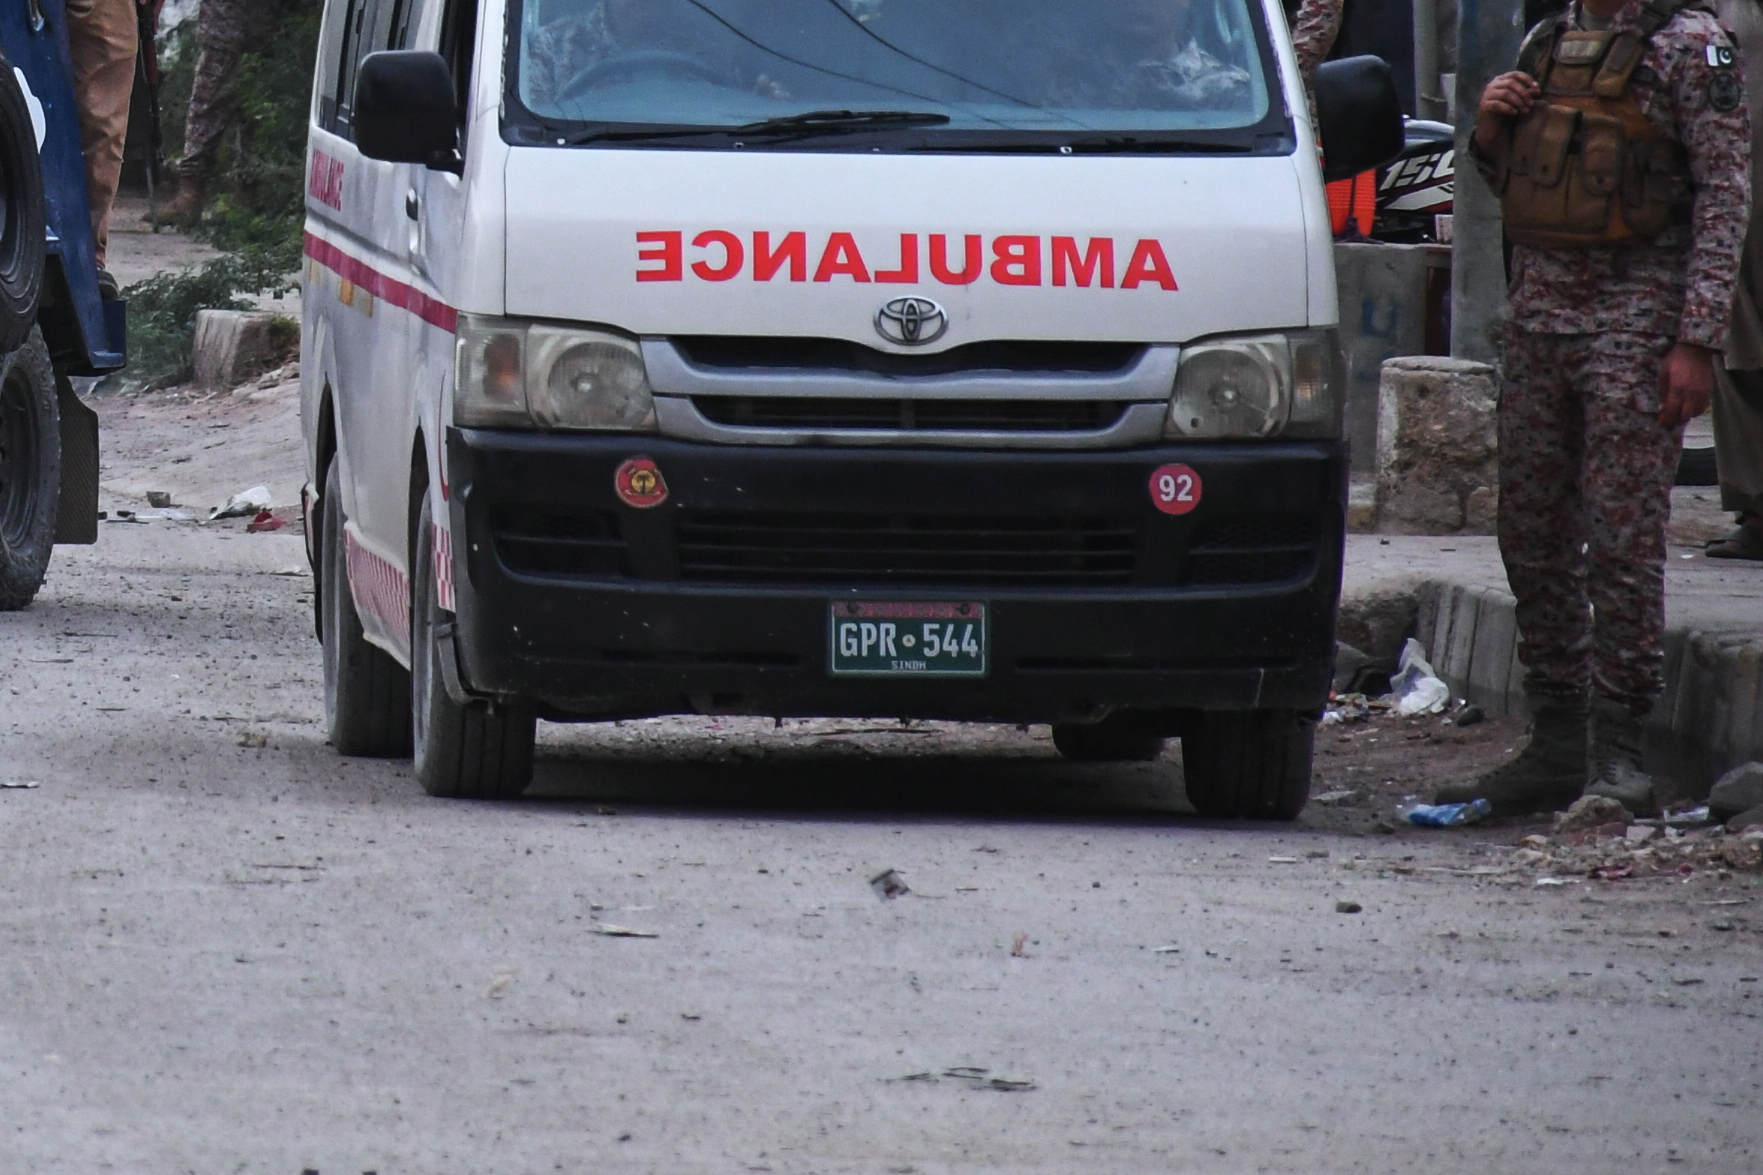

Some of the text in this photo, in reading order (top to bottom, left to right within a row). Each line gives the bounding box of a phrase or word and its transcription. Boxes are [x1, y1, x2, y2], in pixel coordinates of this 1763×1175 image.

[1159, 474, 1193, 502] 92
[840, 622, 979, 657] GPR 544
[891, 660, 927, 670] SINDH
